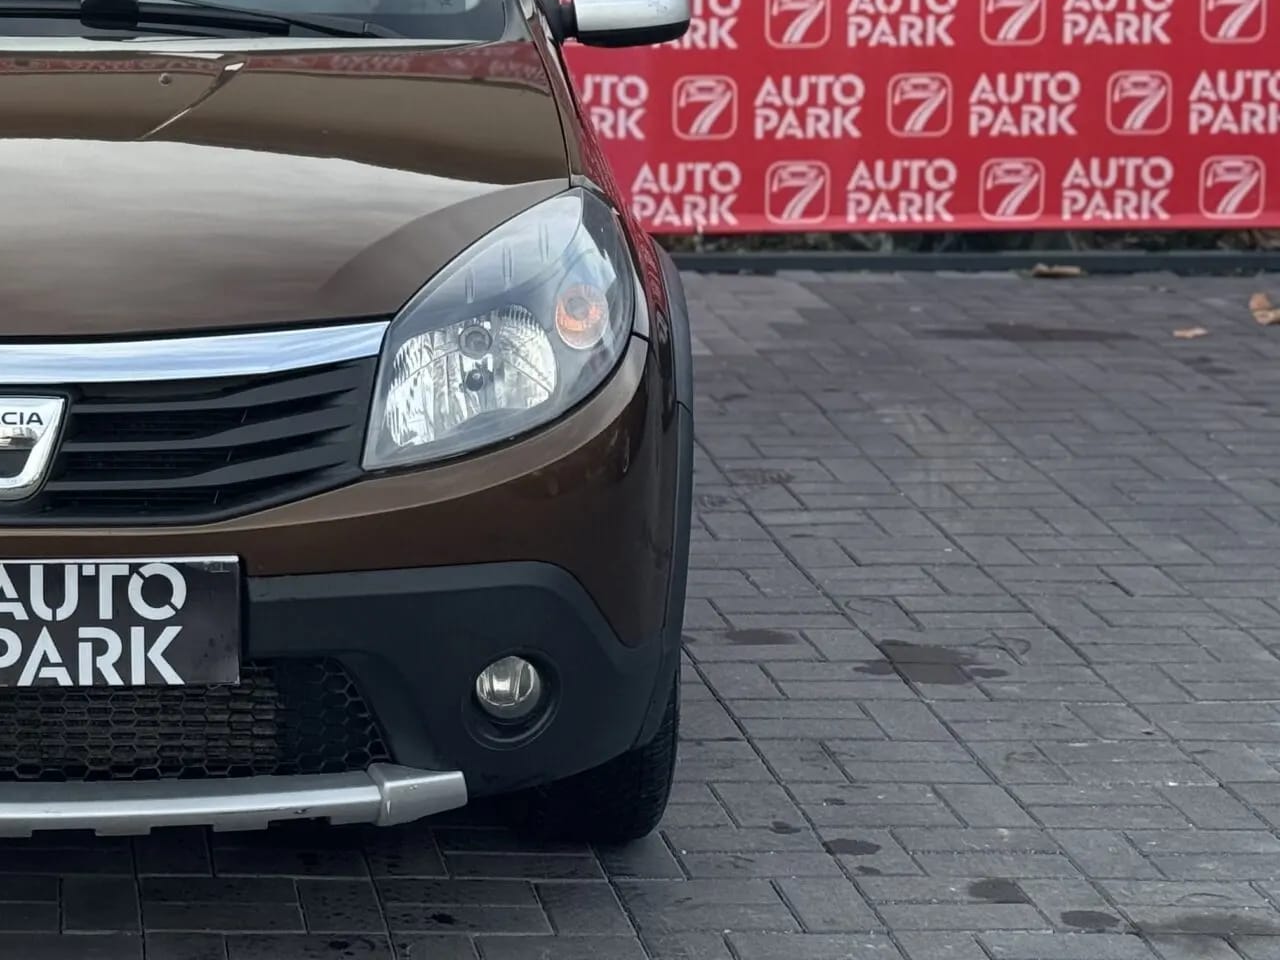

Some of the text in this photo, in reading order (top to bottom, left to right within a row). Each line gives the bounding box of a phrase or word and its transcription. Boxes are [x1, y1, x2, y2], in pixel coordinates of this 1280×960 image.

[848, 14, 954, 47] PARK
[1063, 11, 1170, 44] PARK
[755, 74, 865, 106] AUTO
[969, 72, 1080, 103] AUTO
[755, 106, 861, 139] PARK
[969, 103, 1076, 136] PARK
[631, 162, 741, 193] AUTO
[847, 159, 957, 190] AUTO
[1062, 157, 1173, 188] AUTO
[632, 194, 738, 227] PARK
[847, 190, 954, 223] PARK
[1062, 188, 1169, 220] PARK
